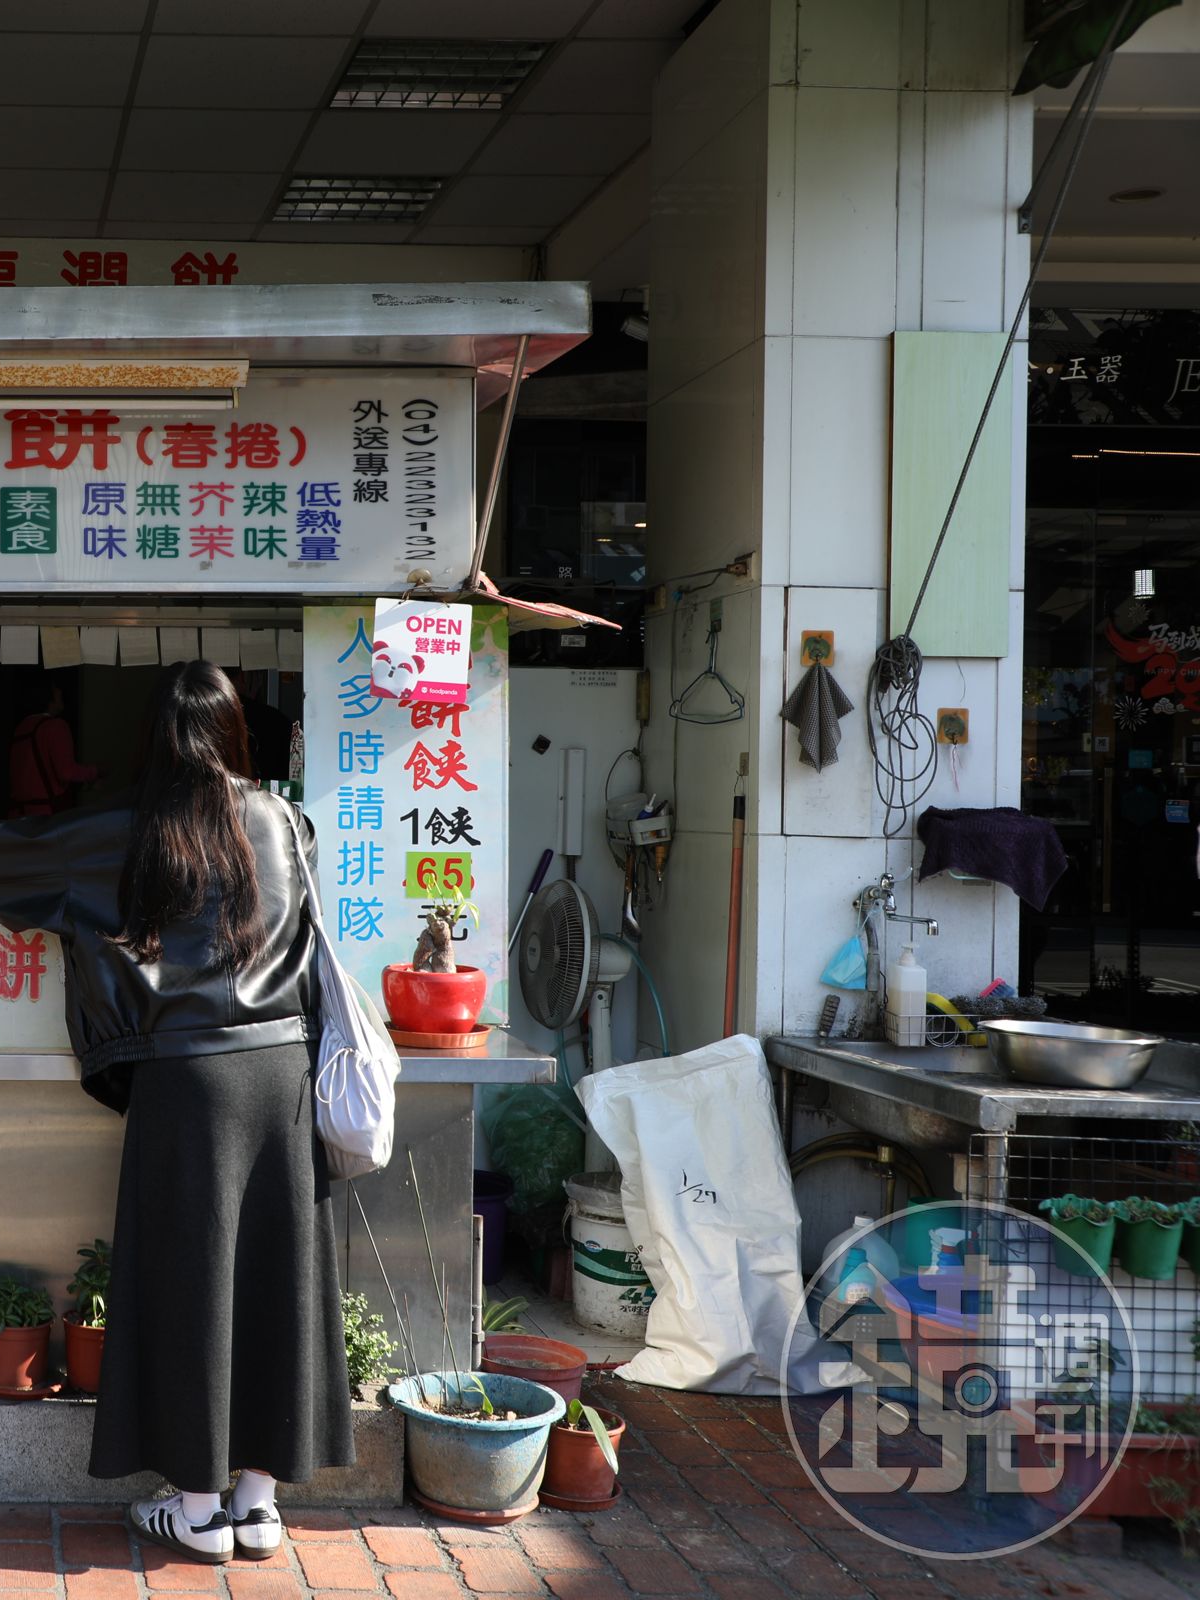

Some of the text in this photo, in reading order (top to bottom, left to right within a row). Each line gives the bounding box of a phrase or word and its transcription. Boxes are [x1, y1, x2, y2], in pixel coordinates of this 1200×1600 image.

[353, 400, 389, 503] 外送專線
[402, 399, 438, 561] (04)22323132
[5, 490, 52, 551] 素食
[82, 483, 127, 559] 原味
[135, 481, 181, 559] 無糖
[242, 481, 288, 560] 辣味
[297, 481, 341, 561] 低熱量
[406, 616, 463, 636] OPEN
[415, 637, 461, 656] 營業中
[429, 688, 458, 696] foodpanda
[337, 617, 385, 942] 人多時請排隊
[416, 857, 464, 890] 65
